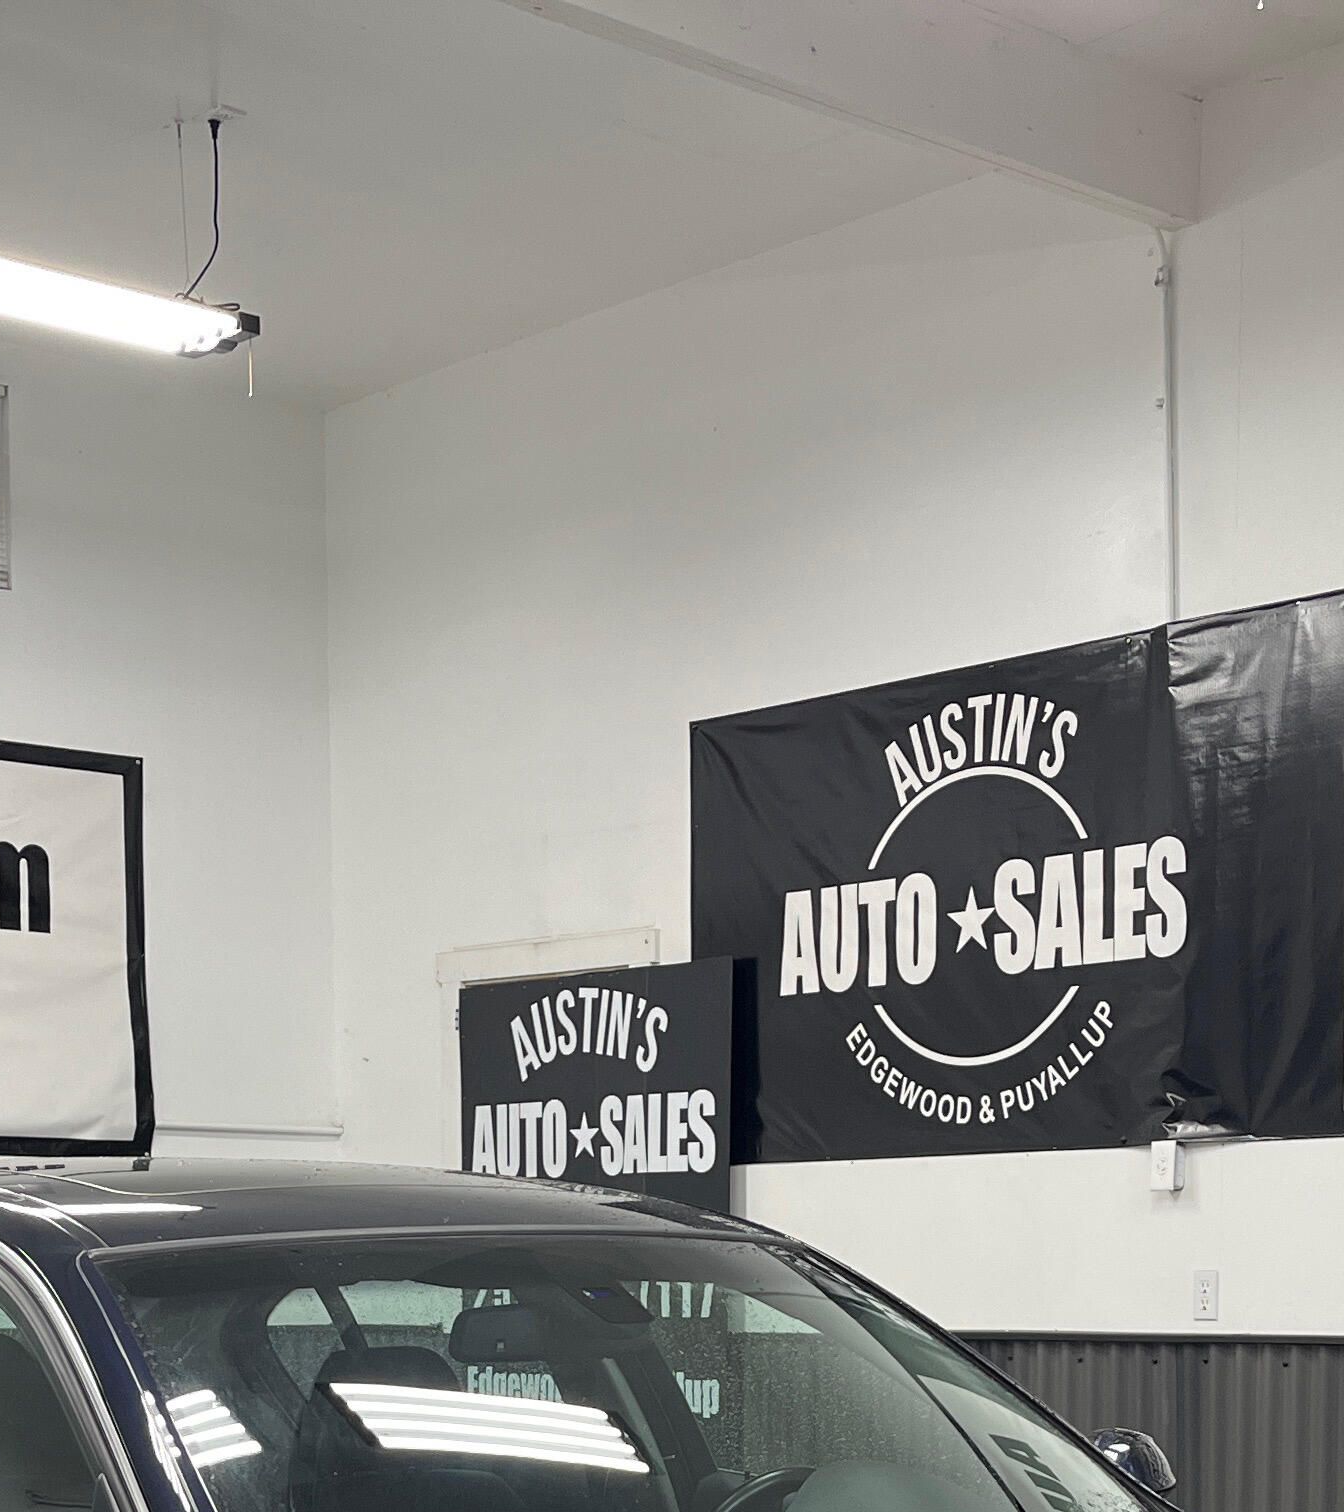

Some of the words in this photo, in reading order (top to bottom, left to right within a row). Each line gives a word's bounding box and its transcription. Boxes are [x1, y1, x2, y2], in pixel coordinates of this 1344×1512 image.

[884, 692, 1078, 808] AUSTIN'S
[779, 872, 938, 997] AUTO
[993, 835, 1187, 975] SALES
[510, 986, 669, 1082] AUSTIN'S
[845, 1022, 973, 1125] EDGEWOOD
[979, 1095, 997, 1124] &
[1000, 1000, 1115, 1120] PUYALLUP
[471, 1098, 568, 1179] AUTO
[599, 1088, 716, 1177] SALES
